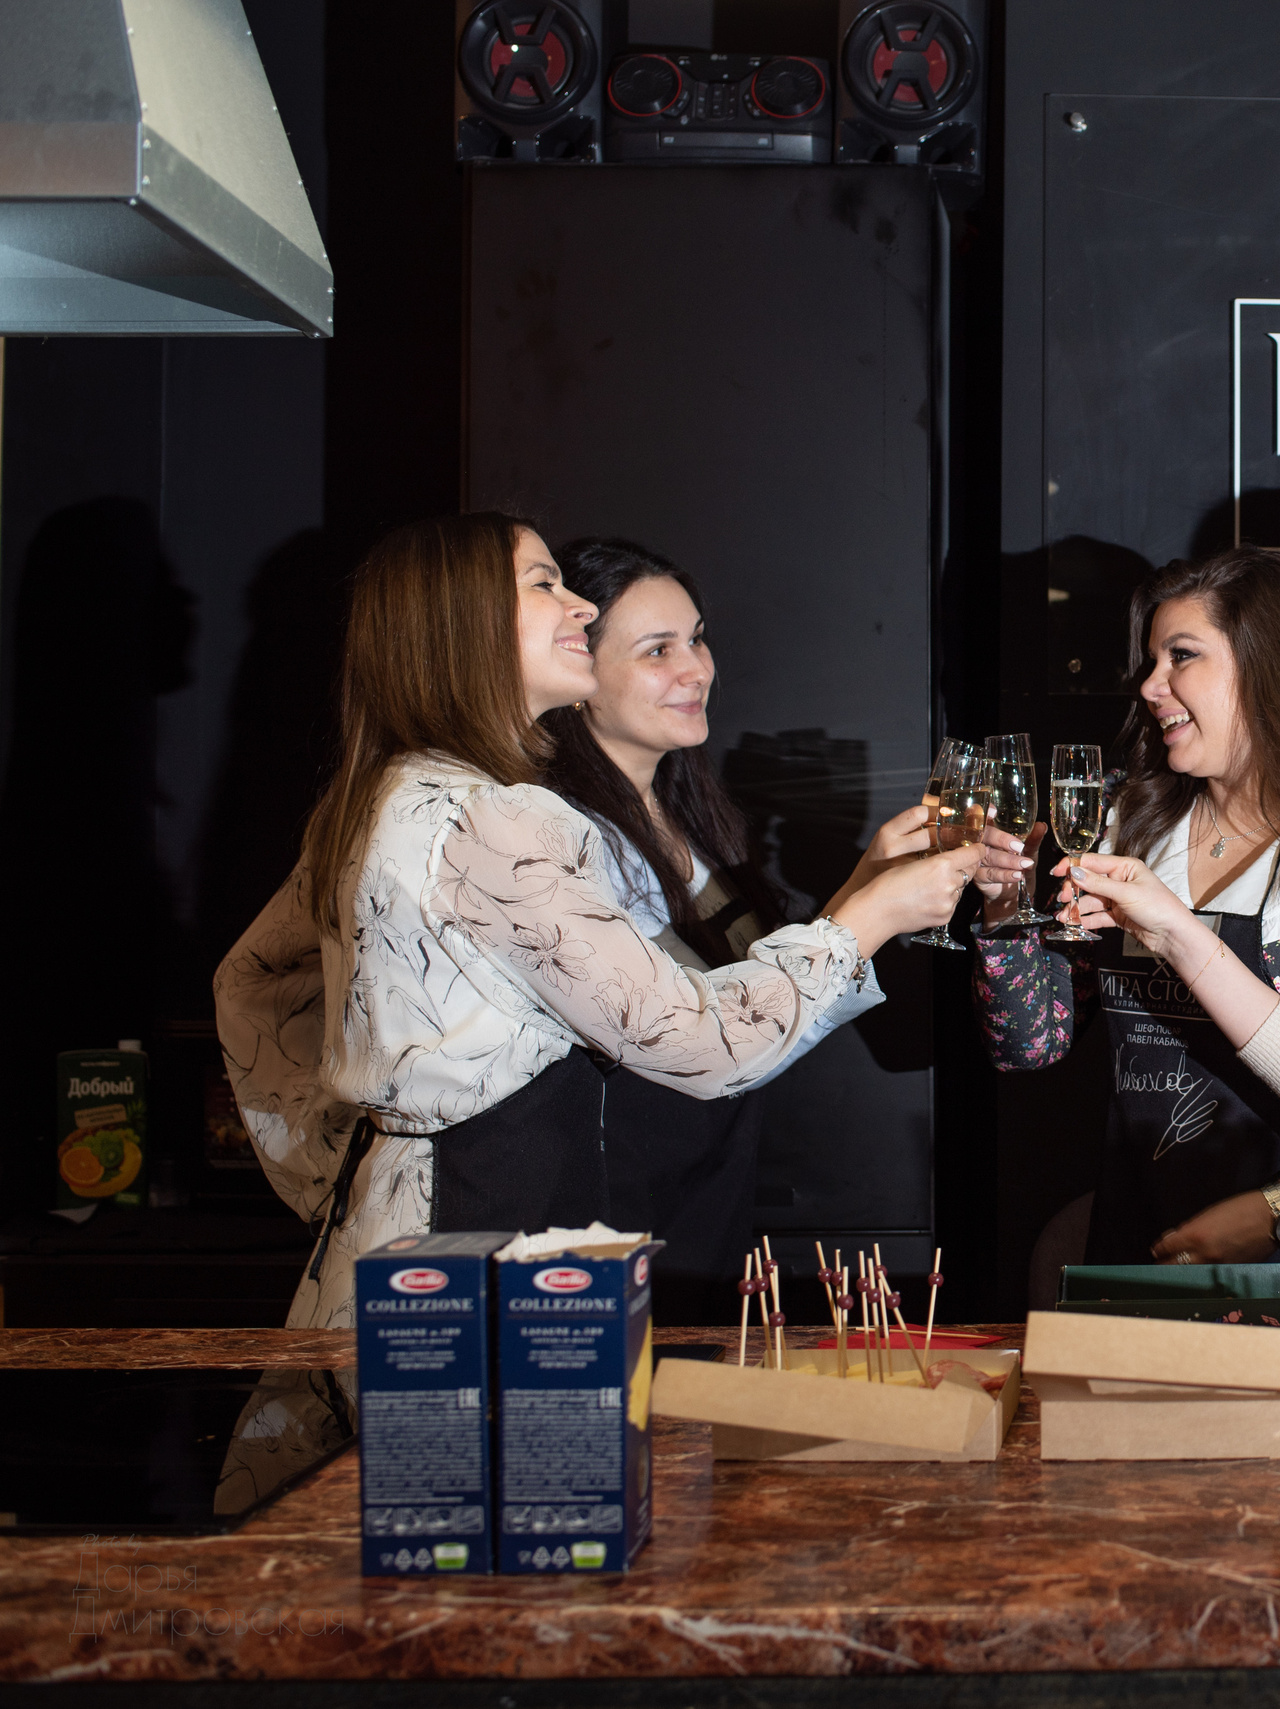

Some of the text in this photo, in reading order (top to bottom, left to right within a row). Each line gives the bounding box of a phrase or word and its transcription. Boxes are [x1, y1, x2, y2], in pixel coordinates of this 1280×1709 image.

[1100, 974, 1144, 999] ИГРА
[1126, 1034, 1153, 1045] ПАВЕЛ
[67, 1075, 135, 1099] Добрый
[365, 1297, 474, 1314] COLLEZIONE
[508, 1297, 617, 1313] COLLEZIONE
